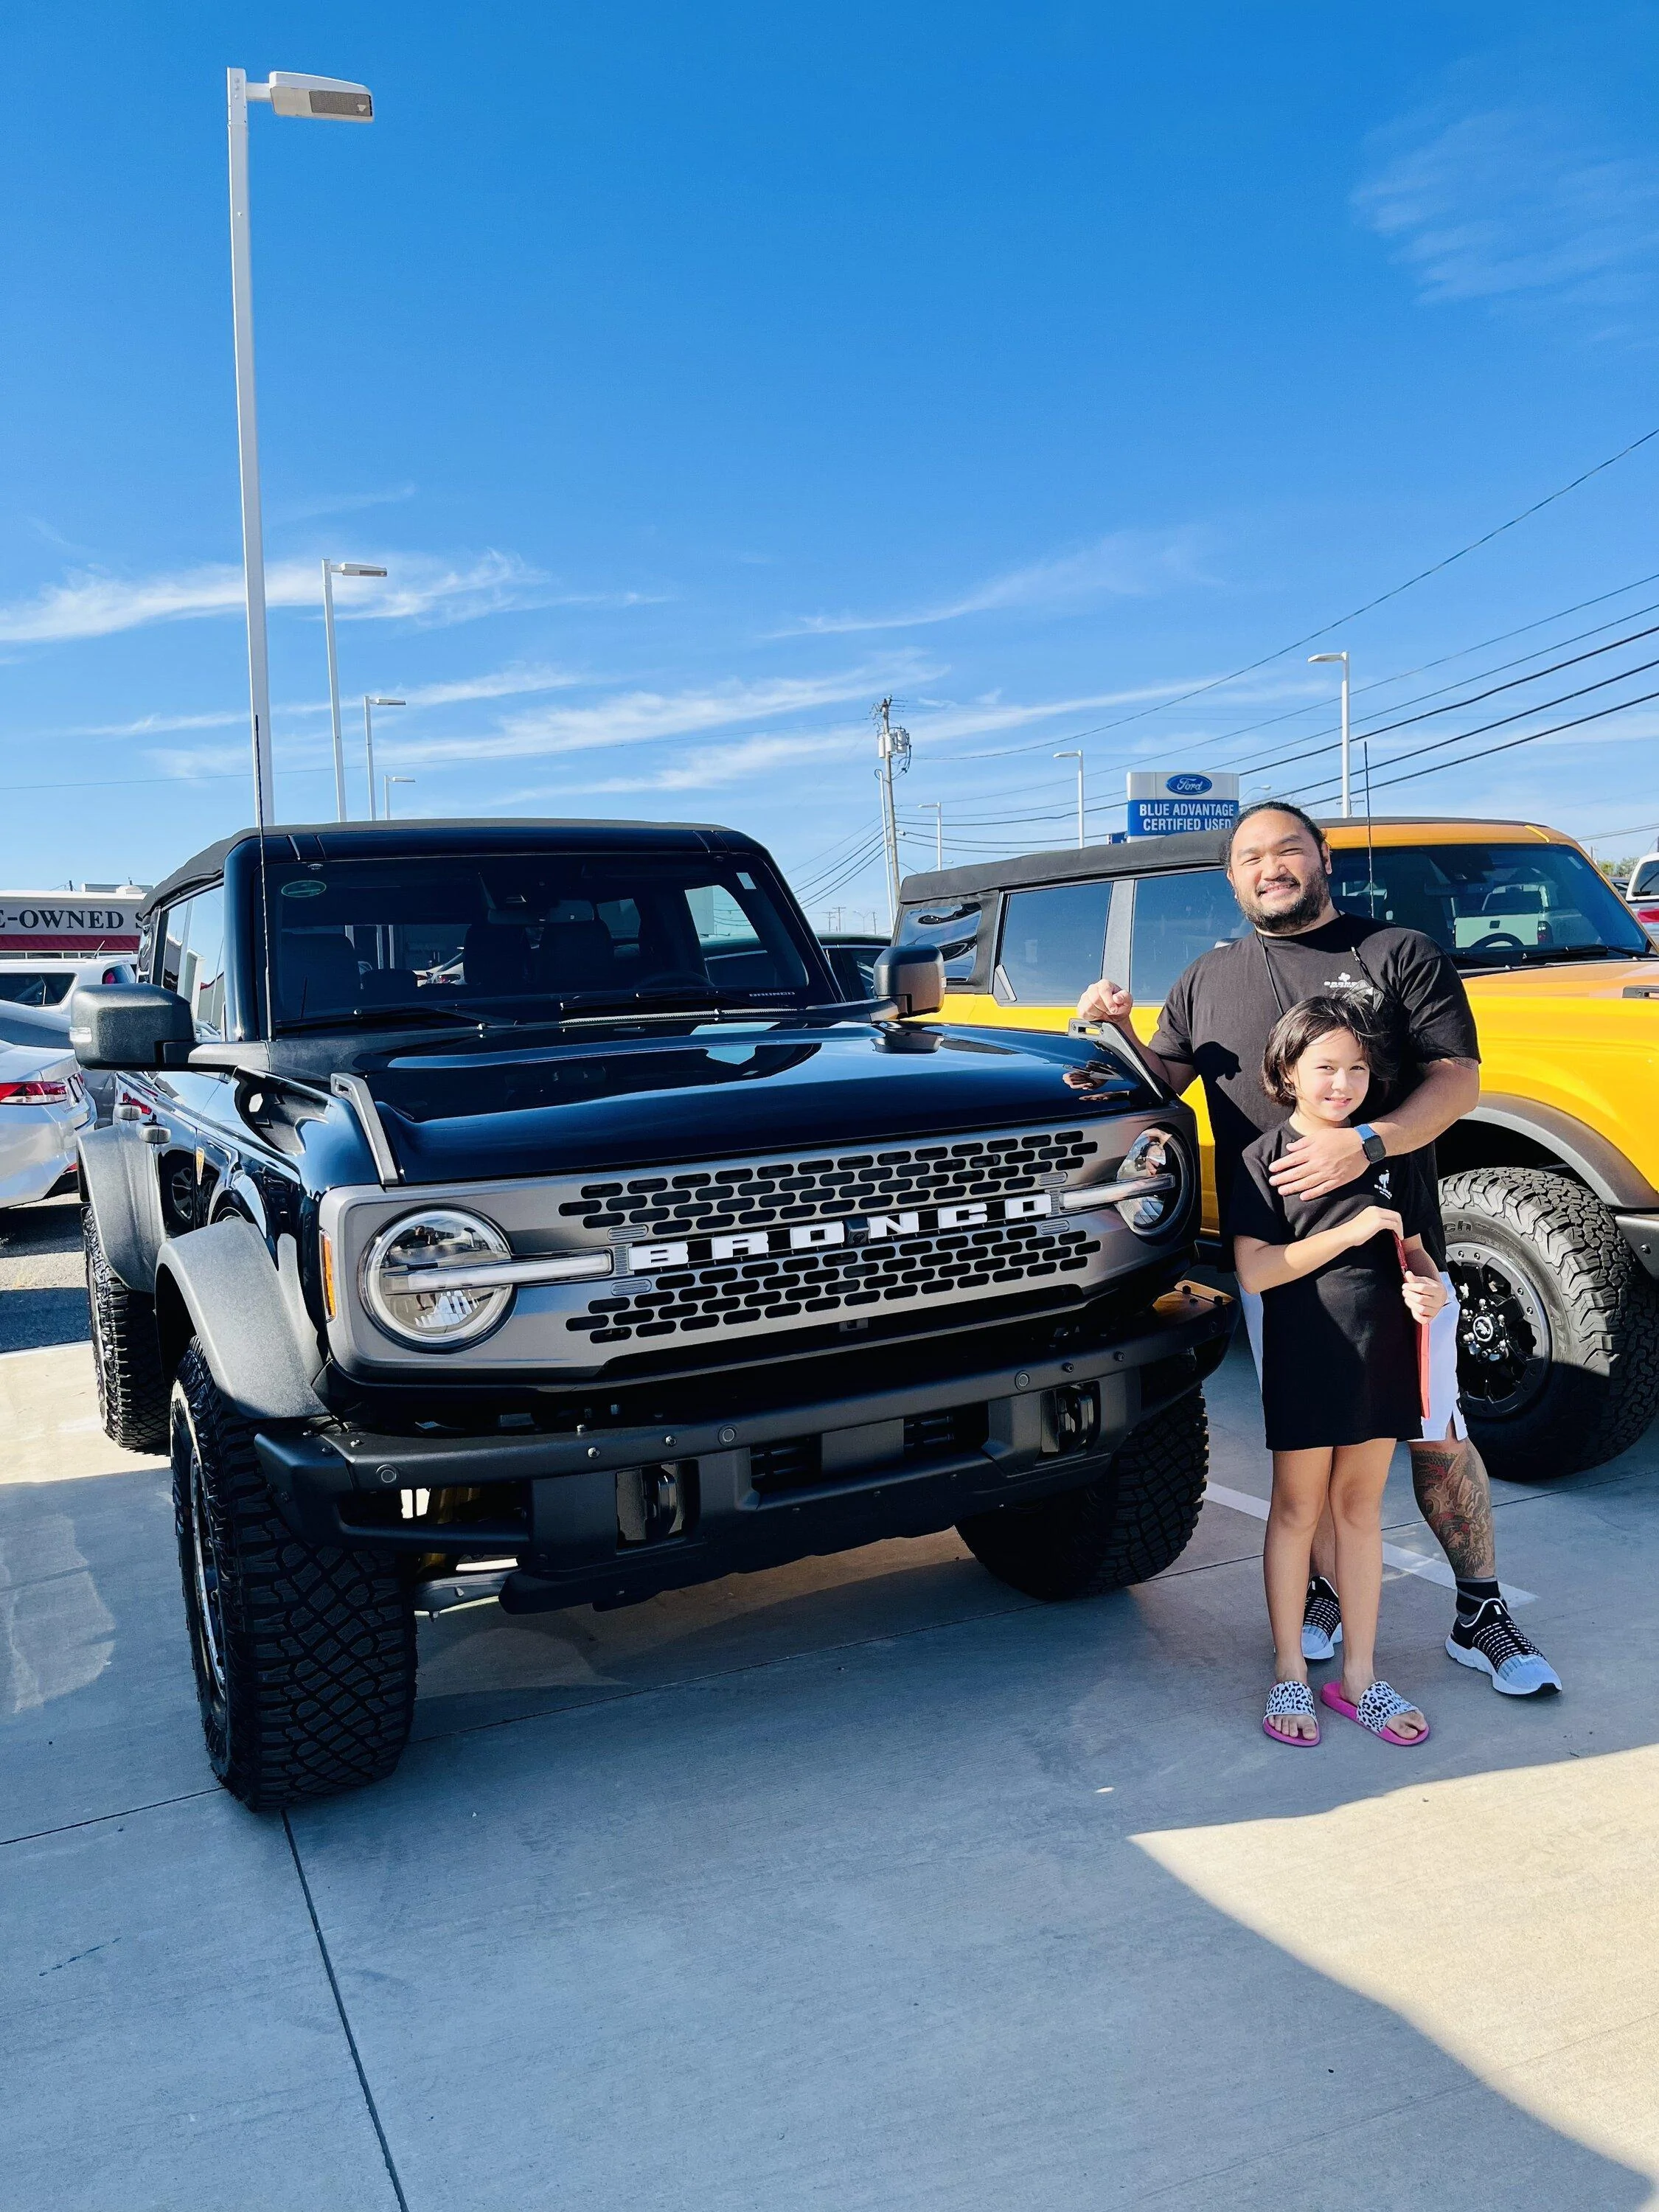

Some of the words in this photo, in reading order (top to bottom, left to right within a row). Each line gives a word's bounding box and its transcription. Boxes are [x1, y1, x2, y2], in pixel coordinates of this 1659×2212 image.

[1176, 777, 1203, 790] Ford
[1139, 803, 1169, 816] BLUE
[1172, 803, 1234, 817] ADVANTAGE
[1143, 818, 1201, 831] CERTIFIED
[1204, 818, 1231, 831] USED
[628, 1193, 1052, 1270] BRONCO
